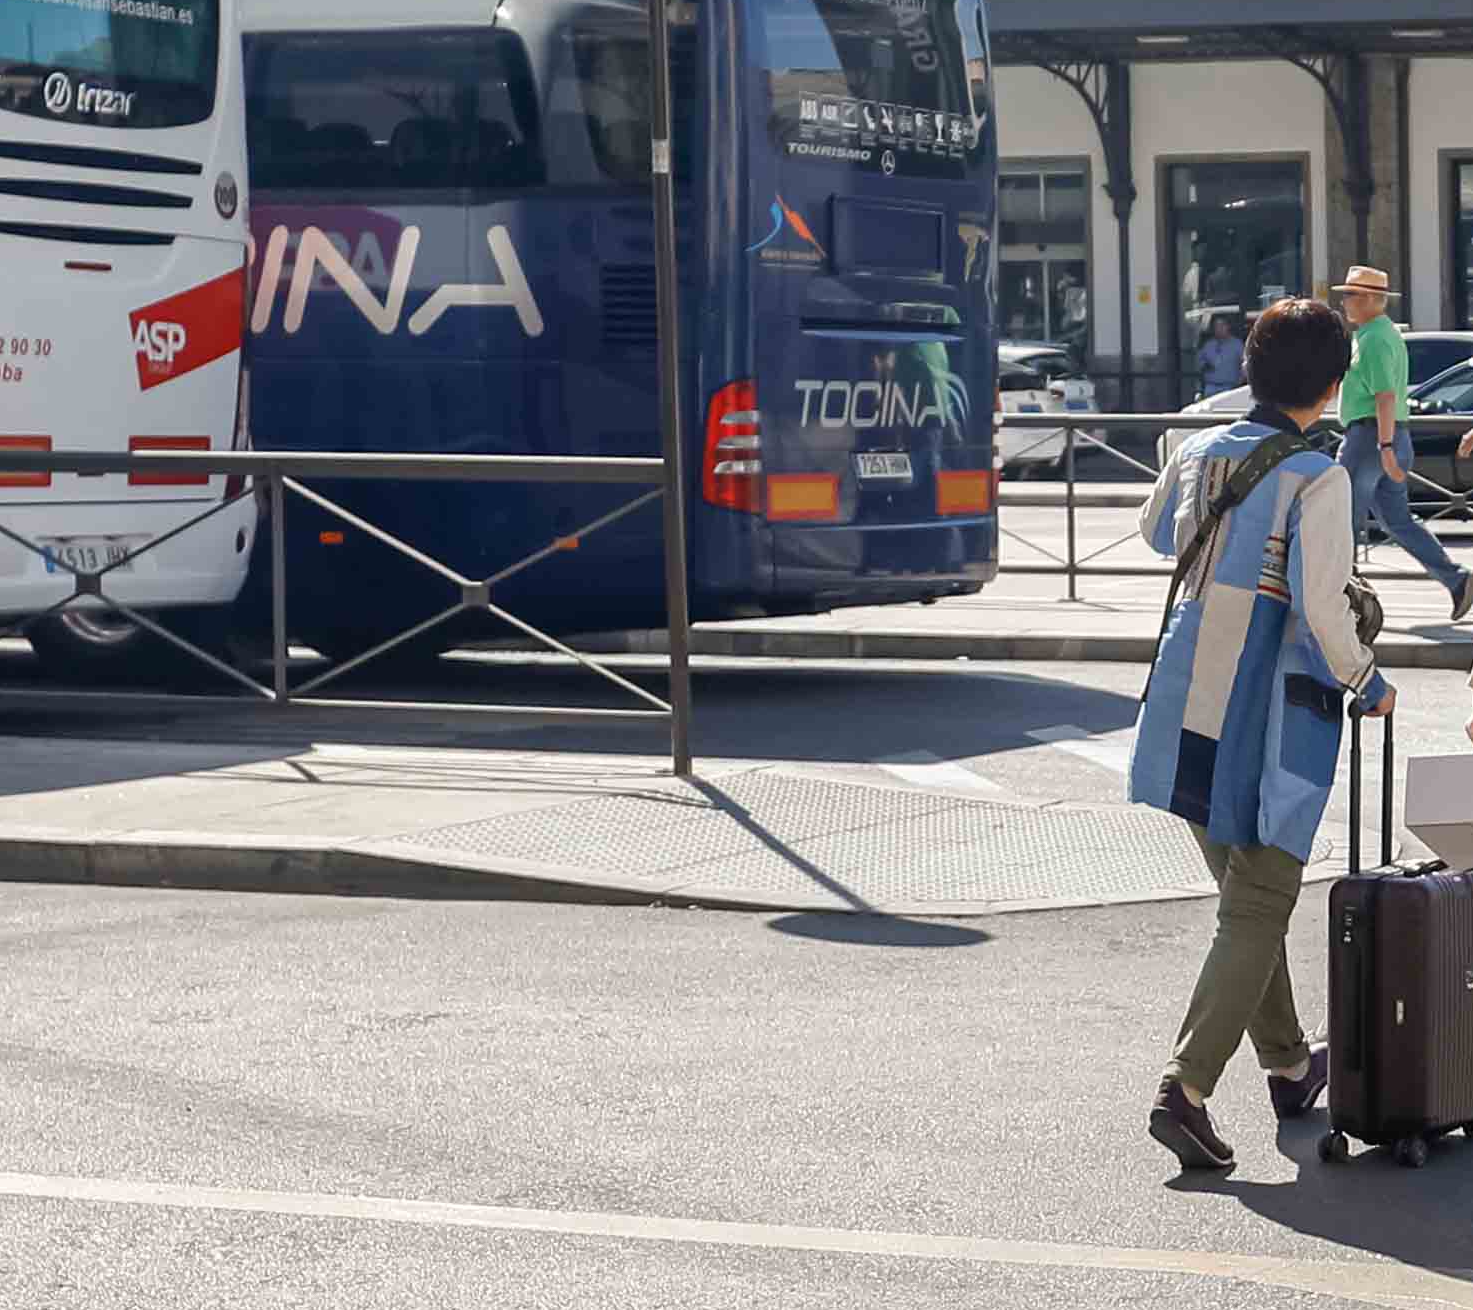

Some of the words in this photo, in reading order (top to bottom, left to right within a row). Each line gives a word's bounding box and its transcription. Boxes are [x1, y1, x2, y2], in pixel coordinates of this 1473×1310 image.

[786, 142, 872, 162] TOURISMO
[248, 224, 544, 337] INA
[11, 337, 28, 355] 90
[34, 338, 52, 356] 30
[130, 320, 186, 362] ASP
[794, 379, 948, 429] TOCINA
